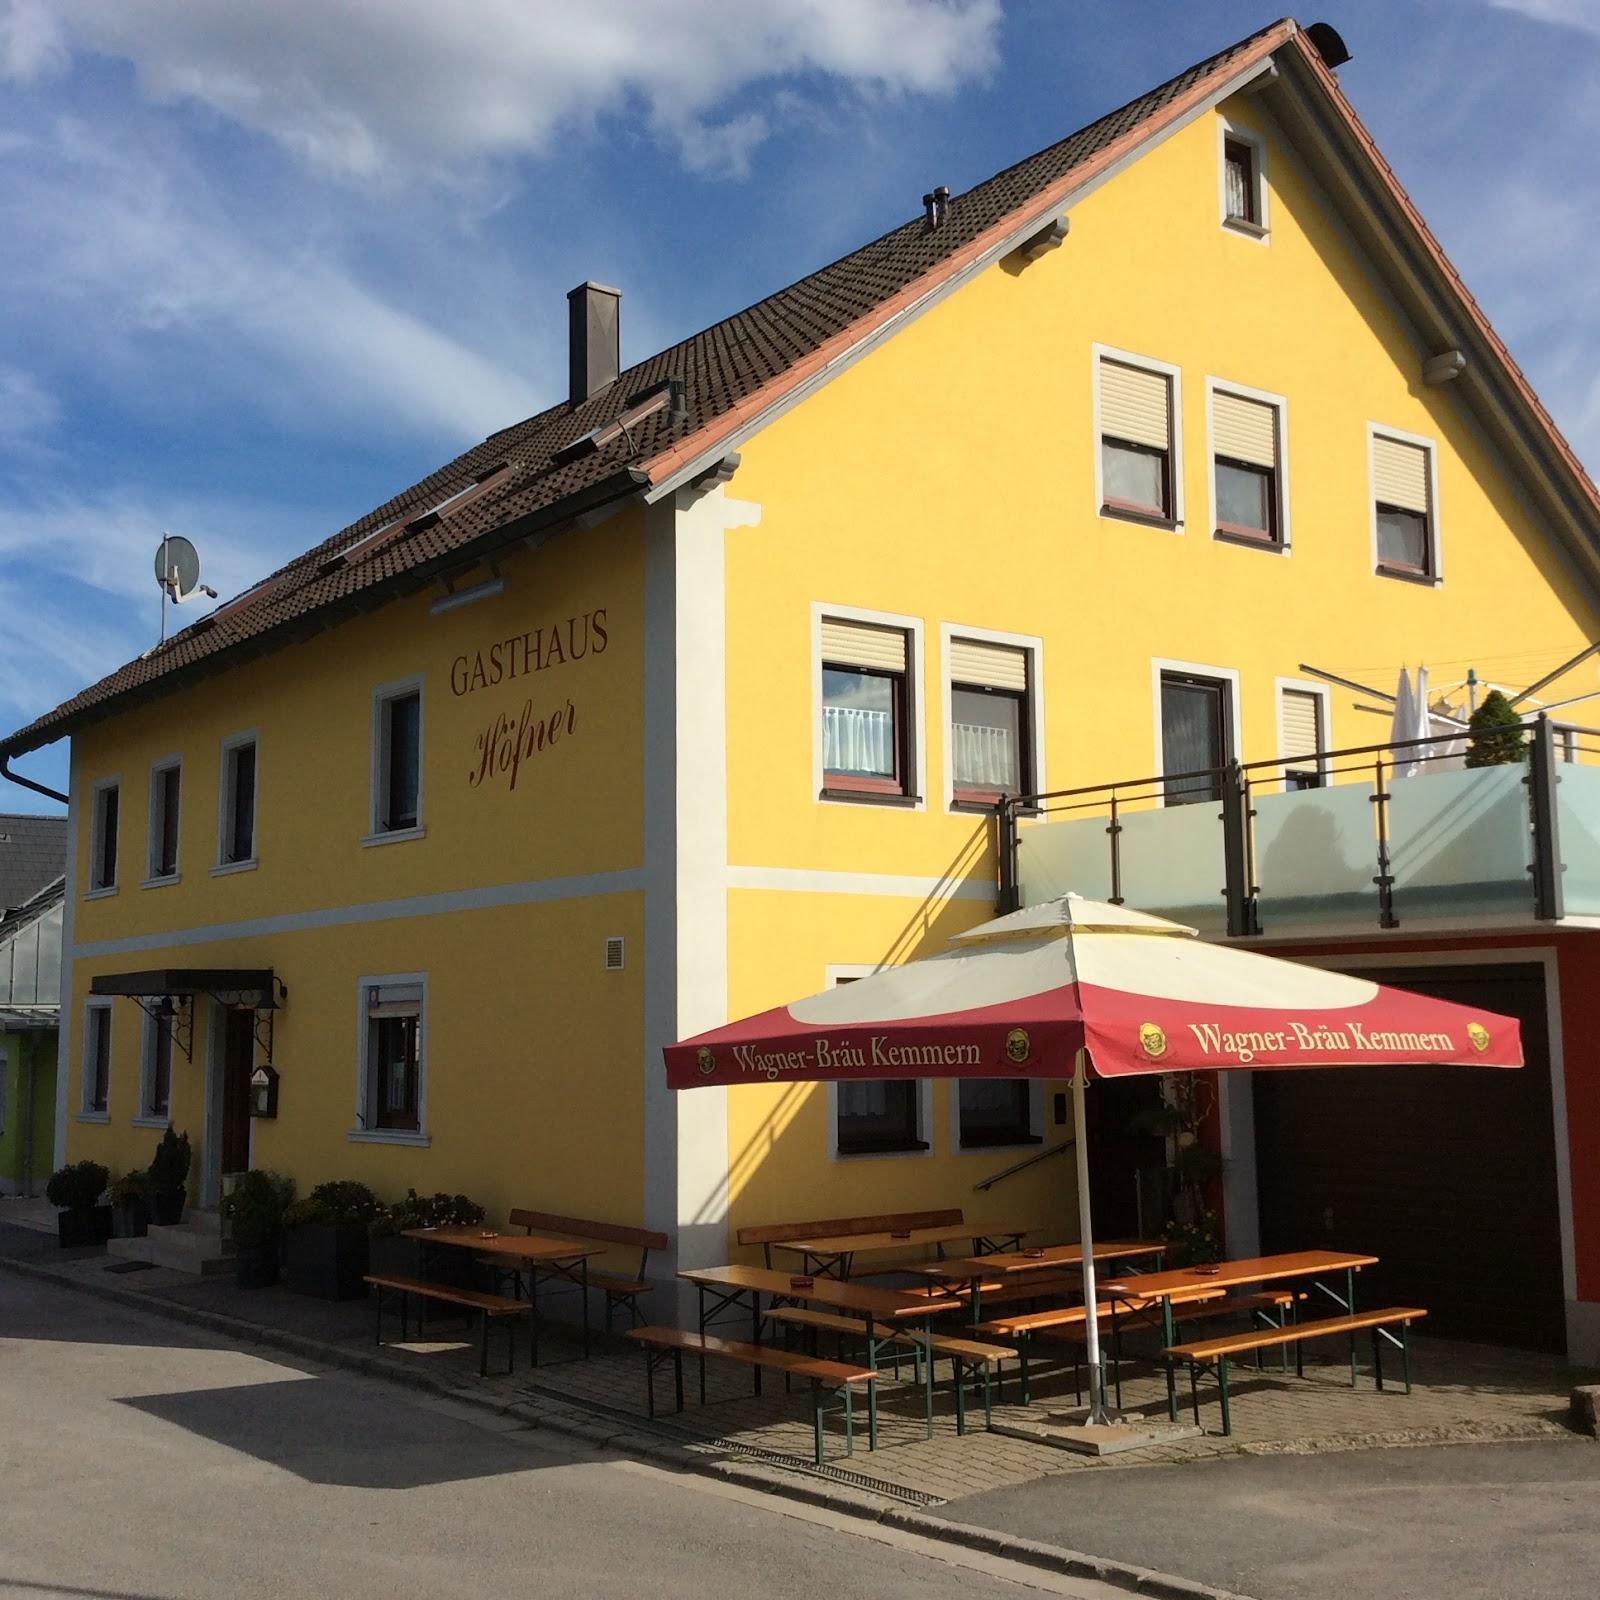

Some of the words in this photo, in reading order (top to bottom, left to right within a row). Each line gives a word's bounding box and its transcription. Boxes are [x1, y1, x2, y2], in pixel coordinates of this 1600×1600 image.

[450, 608, 608, 697] GASTHAUS
[469, 699, 577, 791] Höfner
[732, 1039, 866, 1080] Wagner-Bräu
[871, 1036, 981, 1066] Kemmern
[1187, 1022, 1350, 1063] Wagner-Bräu
[1345, 1022, 1455, 1051] Kemmern
